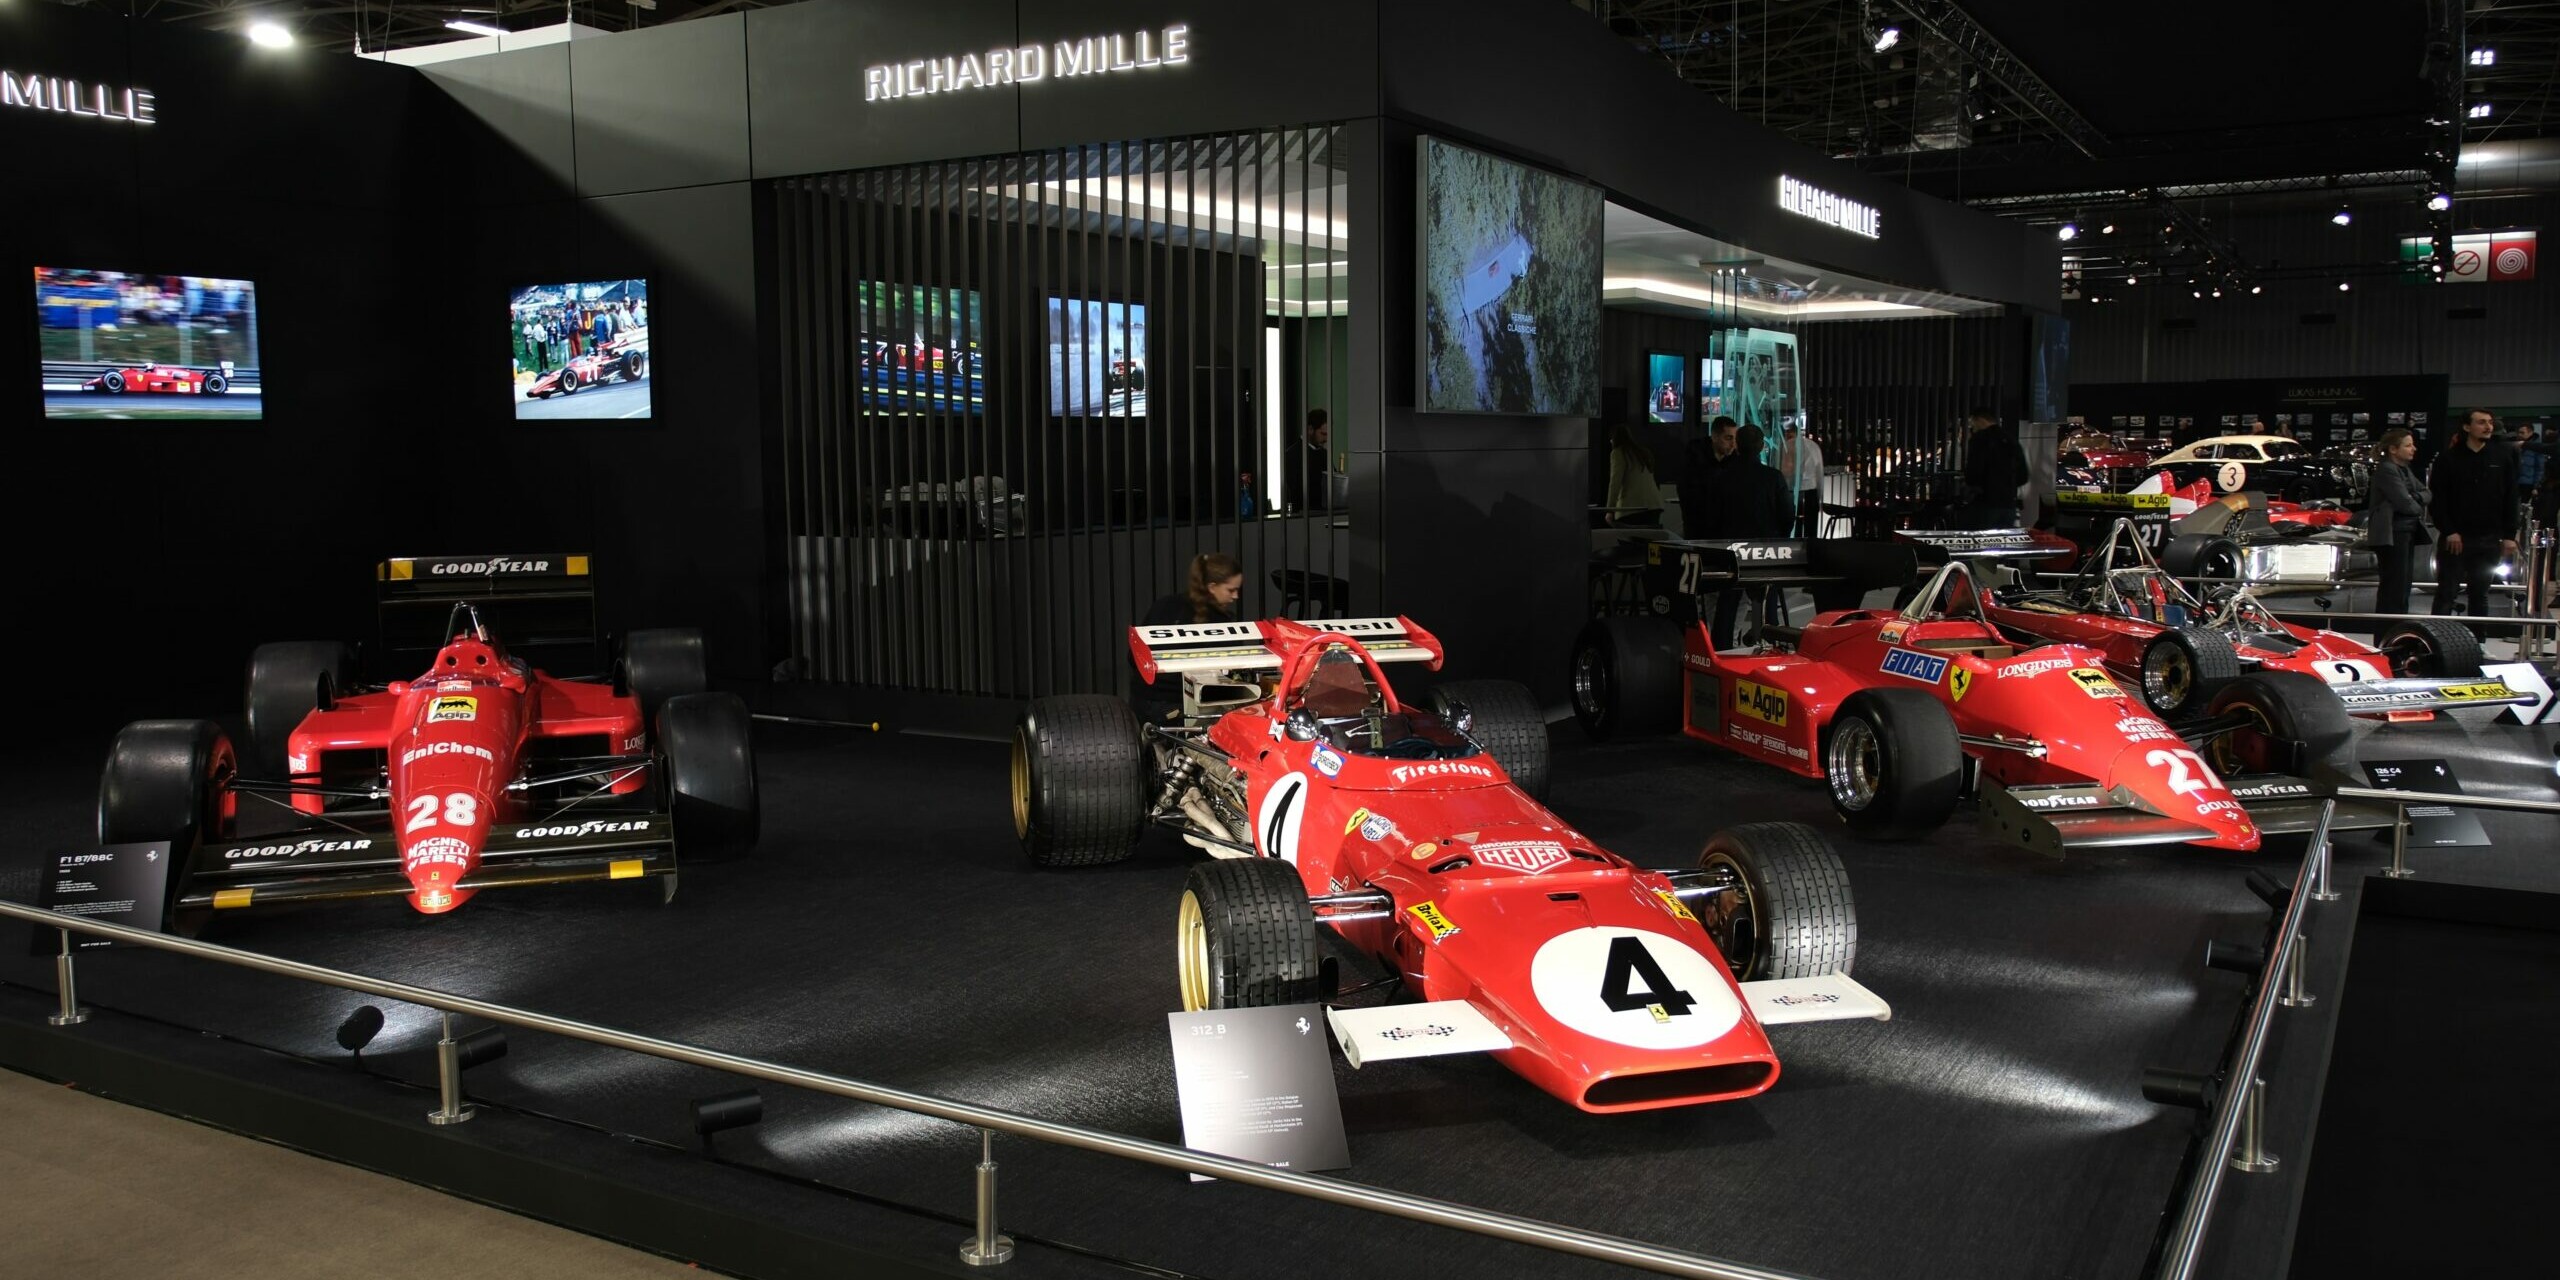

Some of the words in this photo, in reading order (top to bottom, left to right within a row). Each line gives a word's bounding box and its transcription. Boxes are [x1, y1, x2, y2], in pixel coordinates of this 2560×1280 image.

[864, 44, 1042, 101] RICHARD
[1054, 25, 1187, 78] MILLE
[2, 70, 156, 124] MILLE
[1779, 174, 1840, 226] RICHARD
[1840, 198, 1880, 239] MILLE
[2226, 467, 2237, 487] 3
[2147, 495, 2168, 506] Agip
[2141, 524, 2162, 547] 27
[1739, 546, 1793, 561] YEAR
[1679, 553, 1700, 594] 27
[1148, 626, 1250, 639] Shell
[1886, 653, 1942, 678] FIAT
[1997, 657, 2074, 679] LONGINES
[2335, 663, 2361, 682] 2
[2092, 686, 2122, 697] Agip
[2470, 686, 2506, 697] Agip
[1753, 685, 1785, 721] Agip
[433, 712, 471, 720] Agip
[2125, 732, 2178, 743] WEBER
[1392, 761, 1493, 784] Firestone
[2146, 748, 2225, 795] 27
[2375, 767, 2389, 775] 126
[406, 792, 476, 835] 28
[1470, 840, 1561, 850] CHRONOGRAPH
[60, 856, 72, 864] F1
[408, 855, 467, 872] WEBER
[1482, 847, 1565, 870] HEUER
[1416, 904, 1446, 931] Britax
[1600, 936, 1697, 1015] 4
[1191, 1025, 1214, 1036] 312
[1216, 1023, 1227, 1035] B
